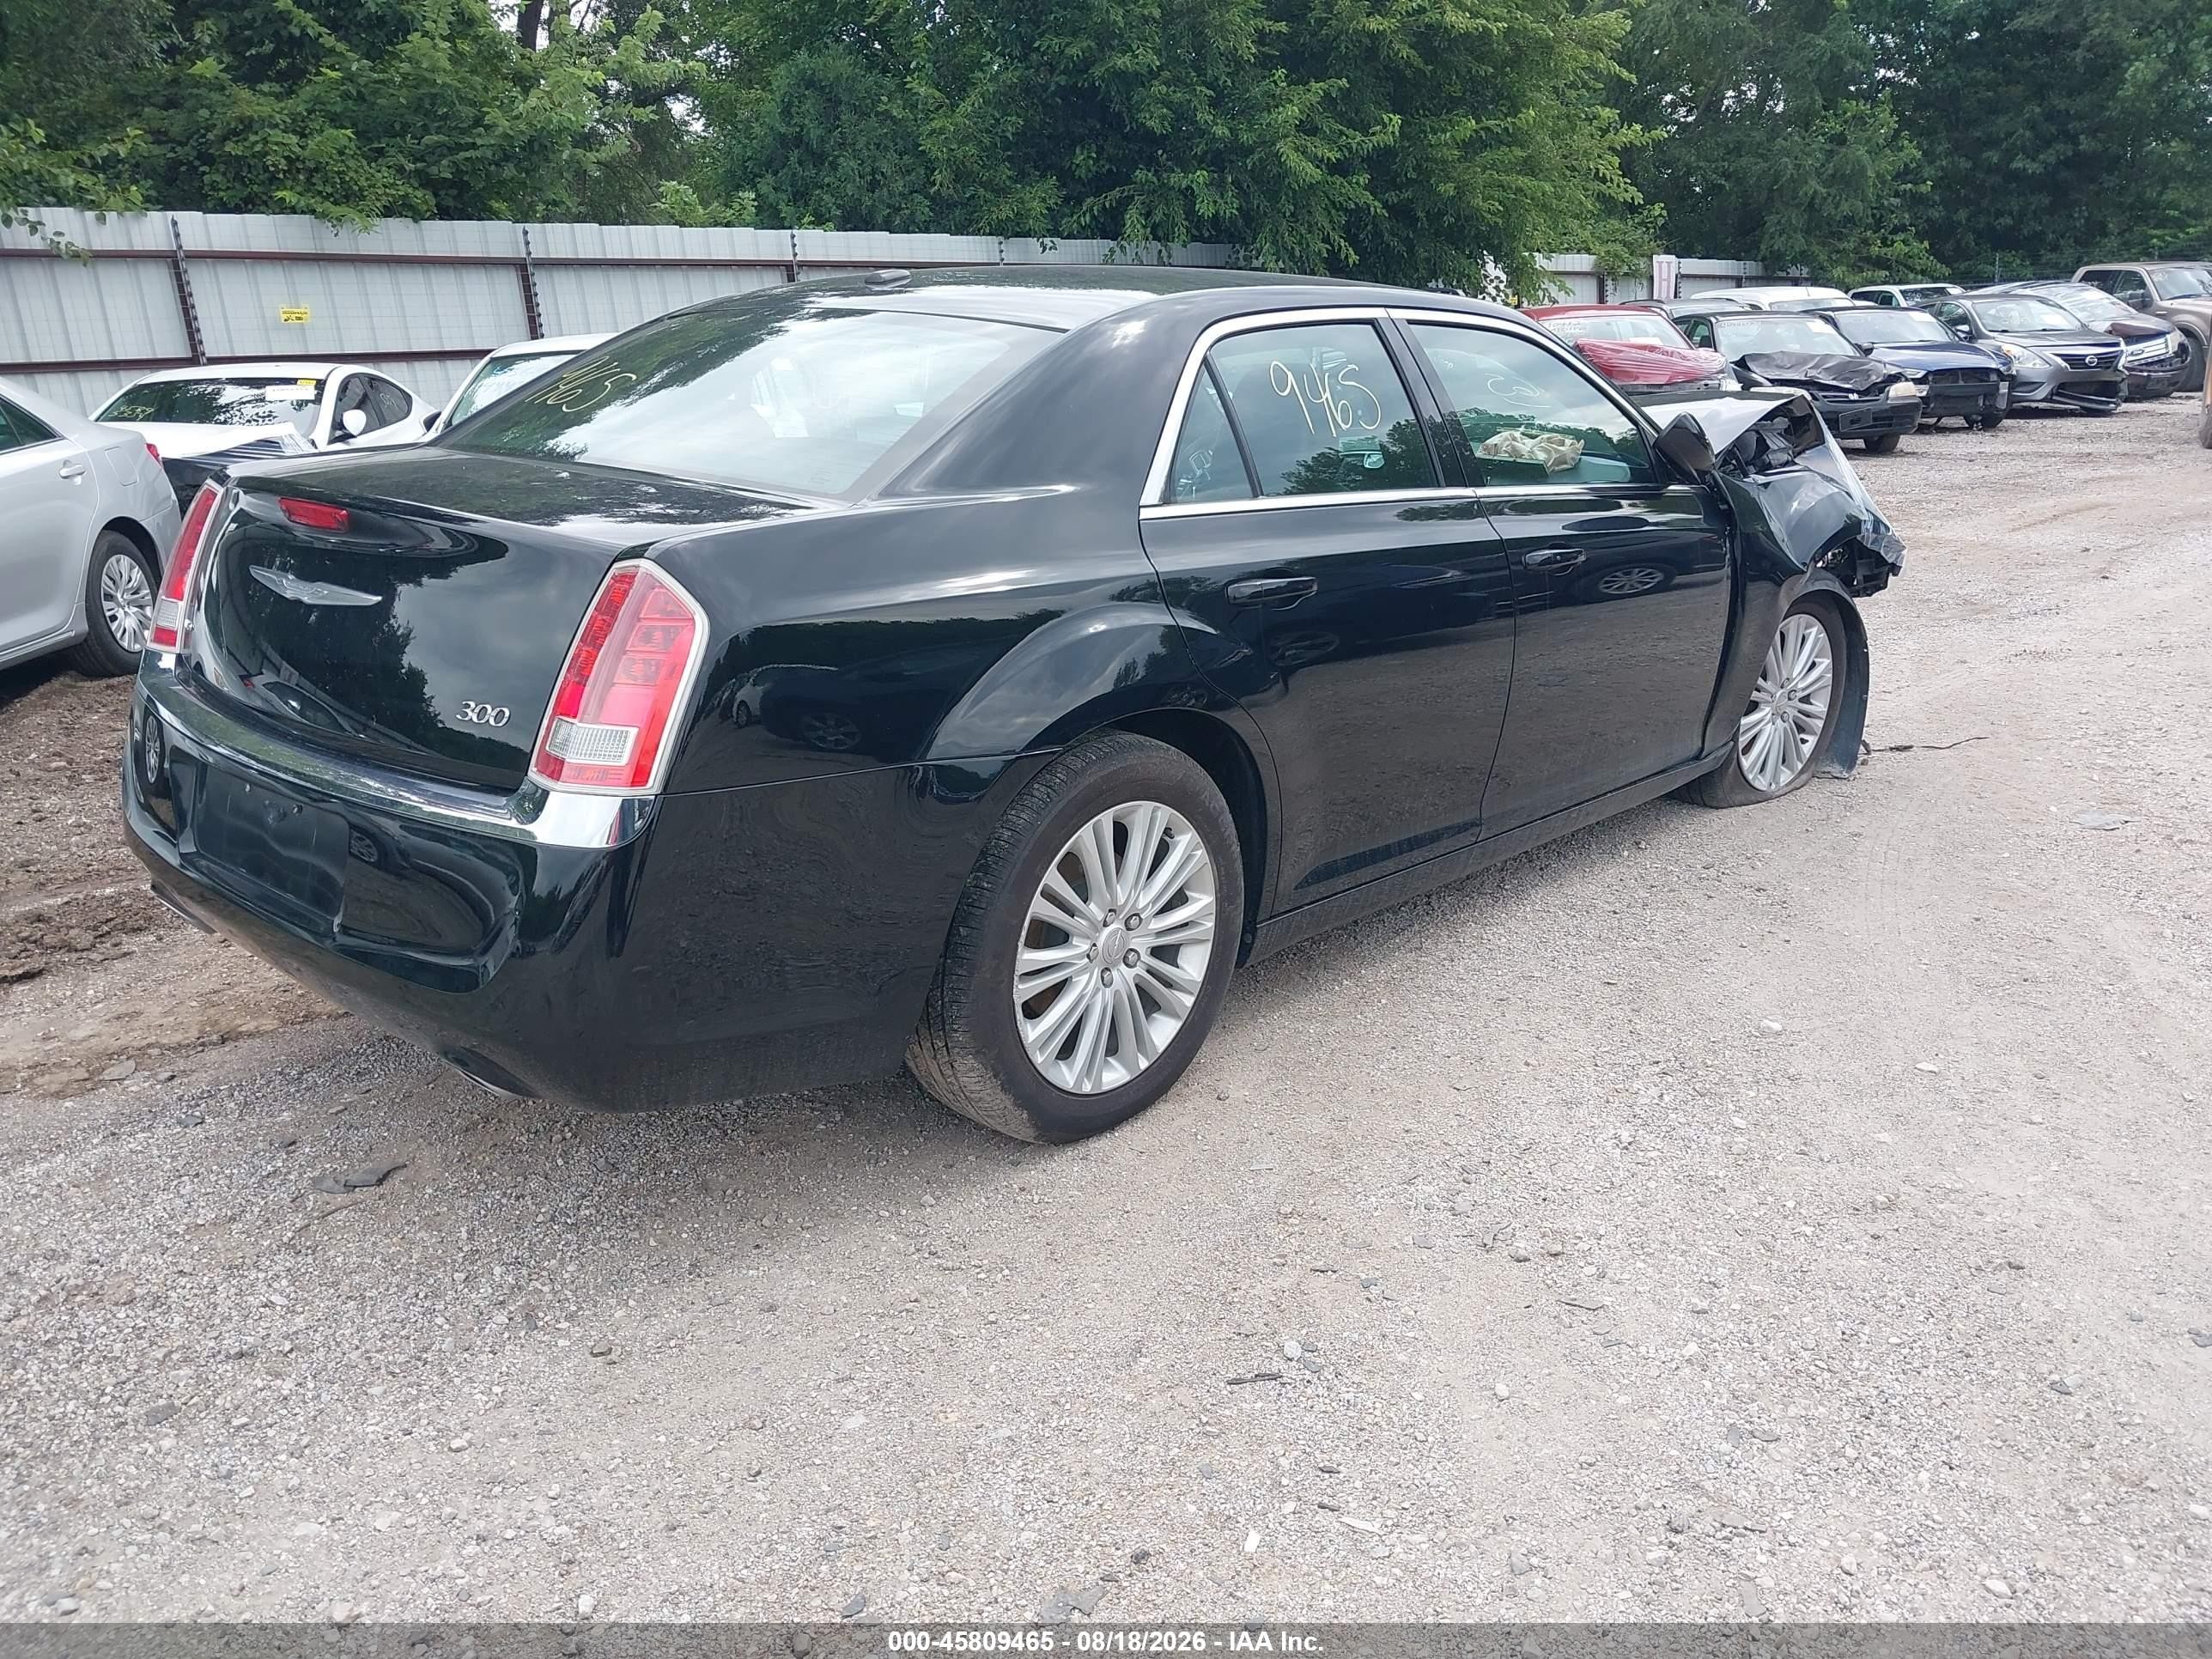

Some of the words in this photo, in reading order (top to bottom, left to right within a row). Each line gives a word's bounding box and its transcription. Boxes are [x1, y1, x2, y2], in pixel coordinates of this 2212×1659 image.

[524, 355, 638, 414] 9465
[1269, 360, 1382, 438] 9465
[455, 700, 510, 727] 300
